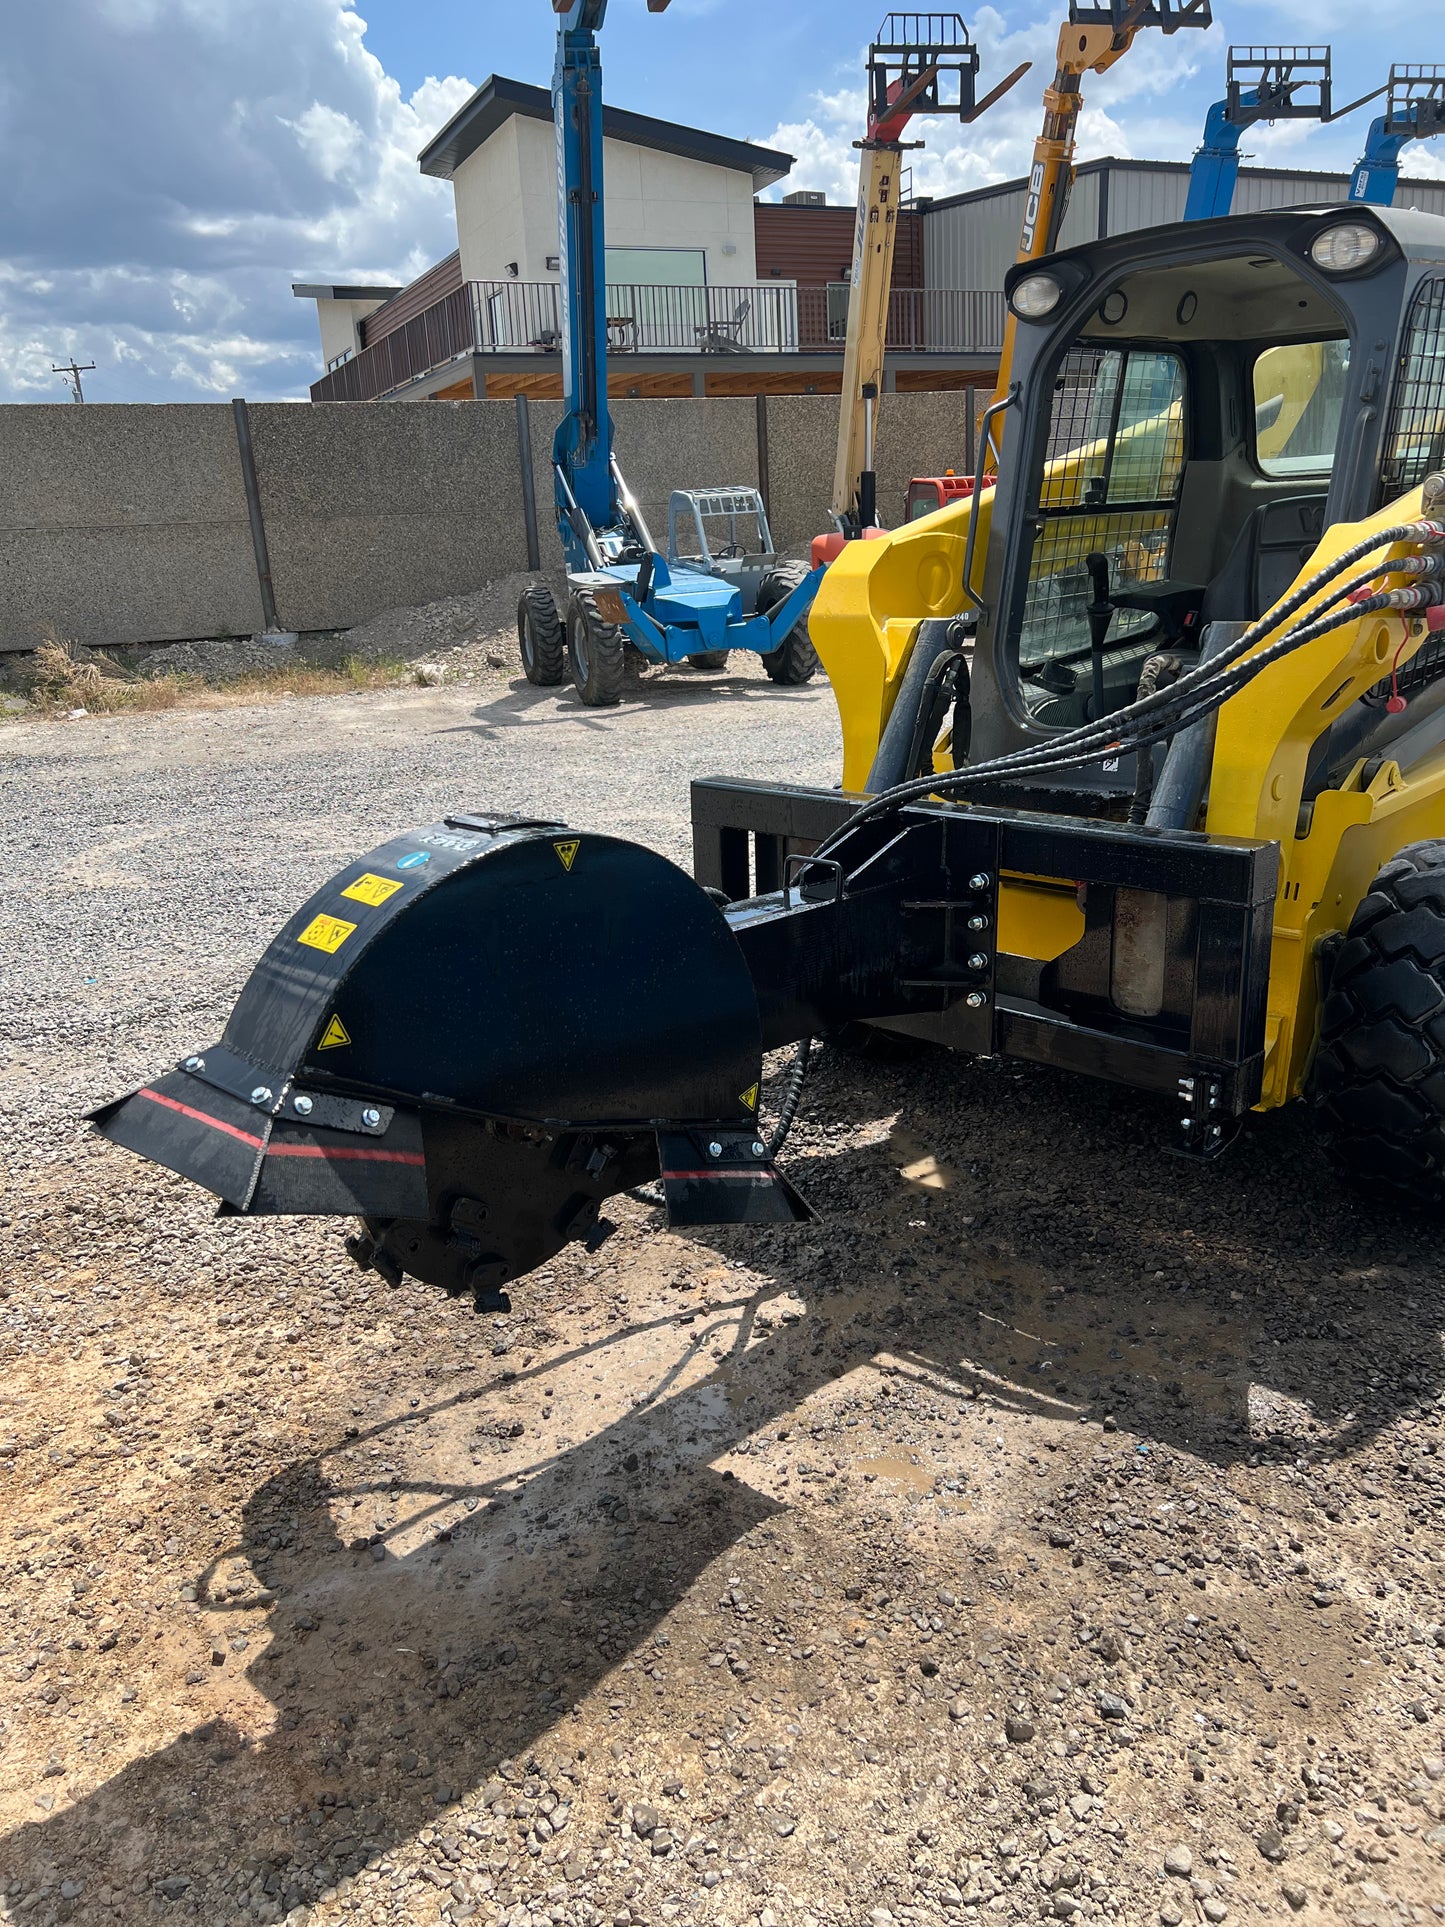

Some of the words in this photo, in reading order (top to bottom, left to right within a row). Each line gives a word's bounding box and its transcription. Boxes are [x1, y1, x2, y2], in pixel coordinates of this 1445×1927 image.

[856, 194, 866, 258] JLG
[1022, 163, 1044, 252] JCB
[560, 284, 570, 357] Genie
